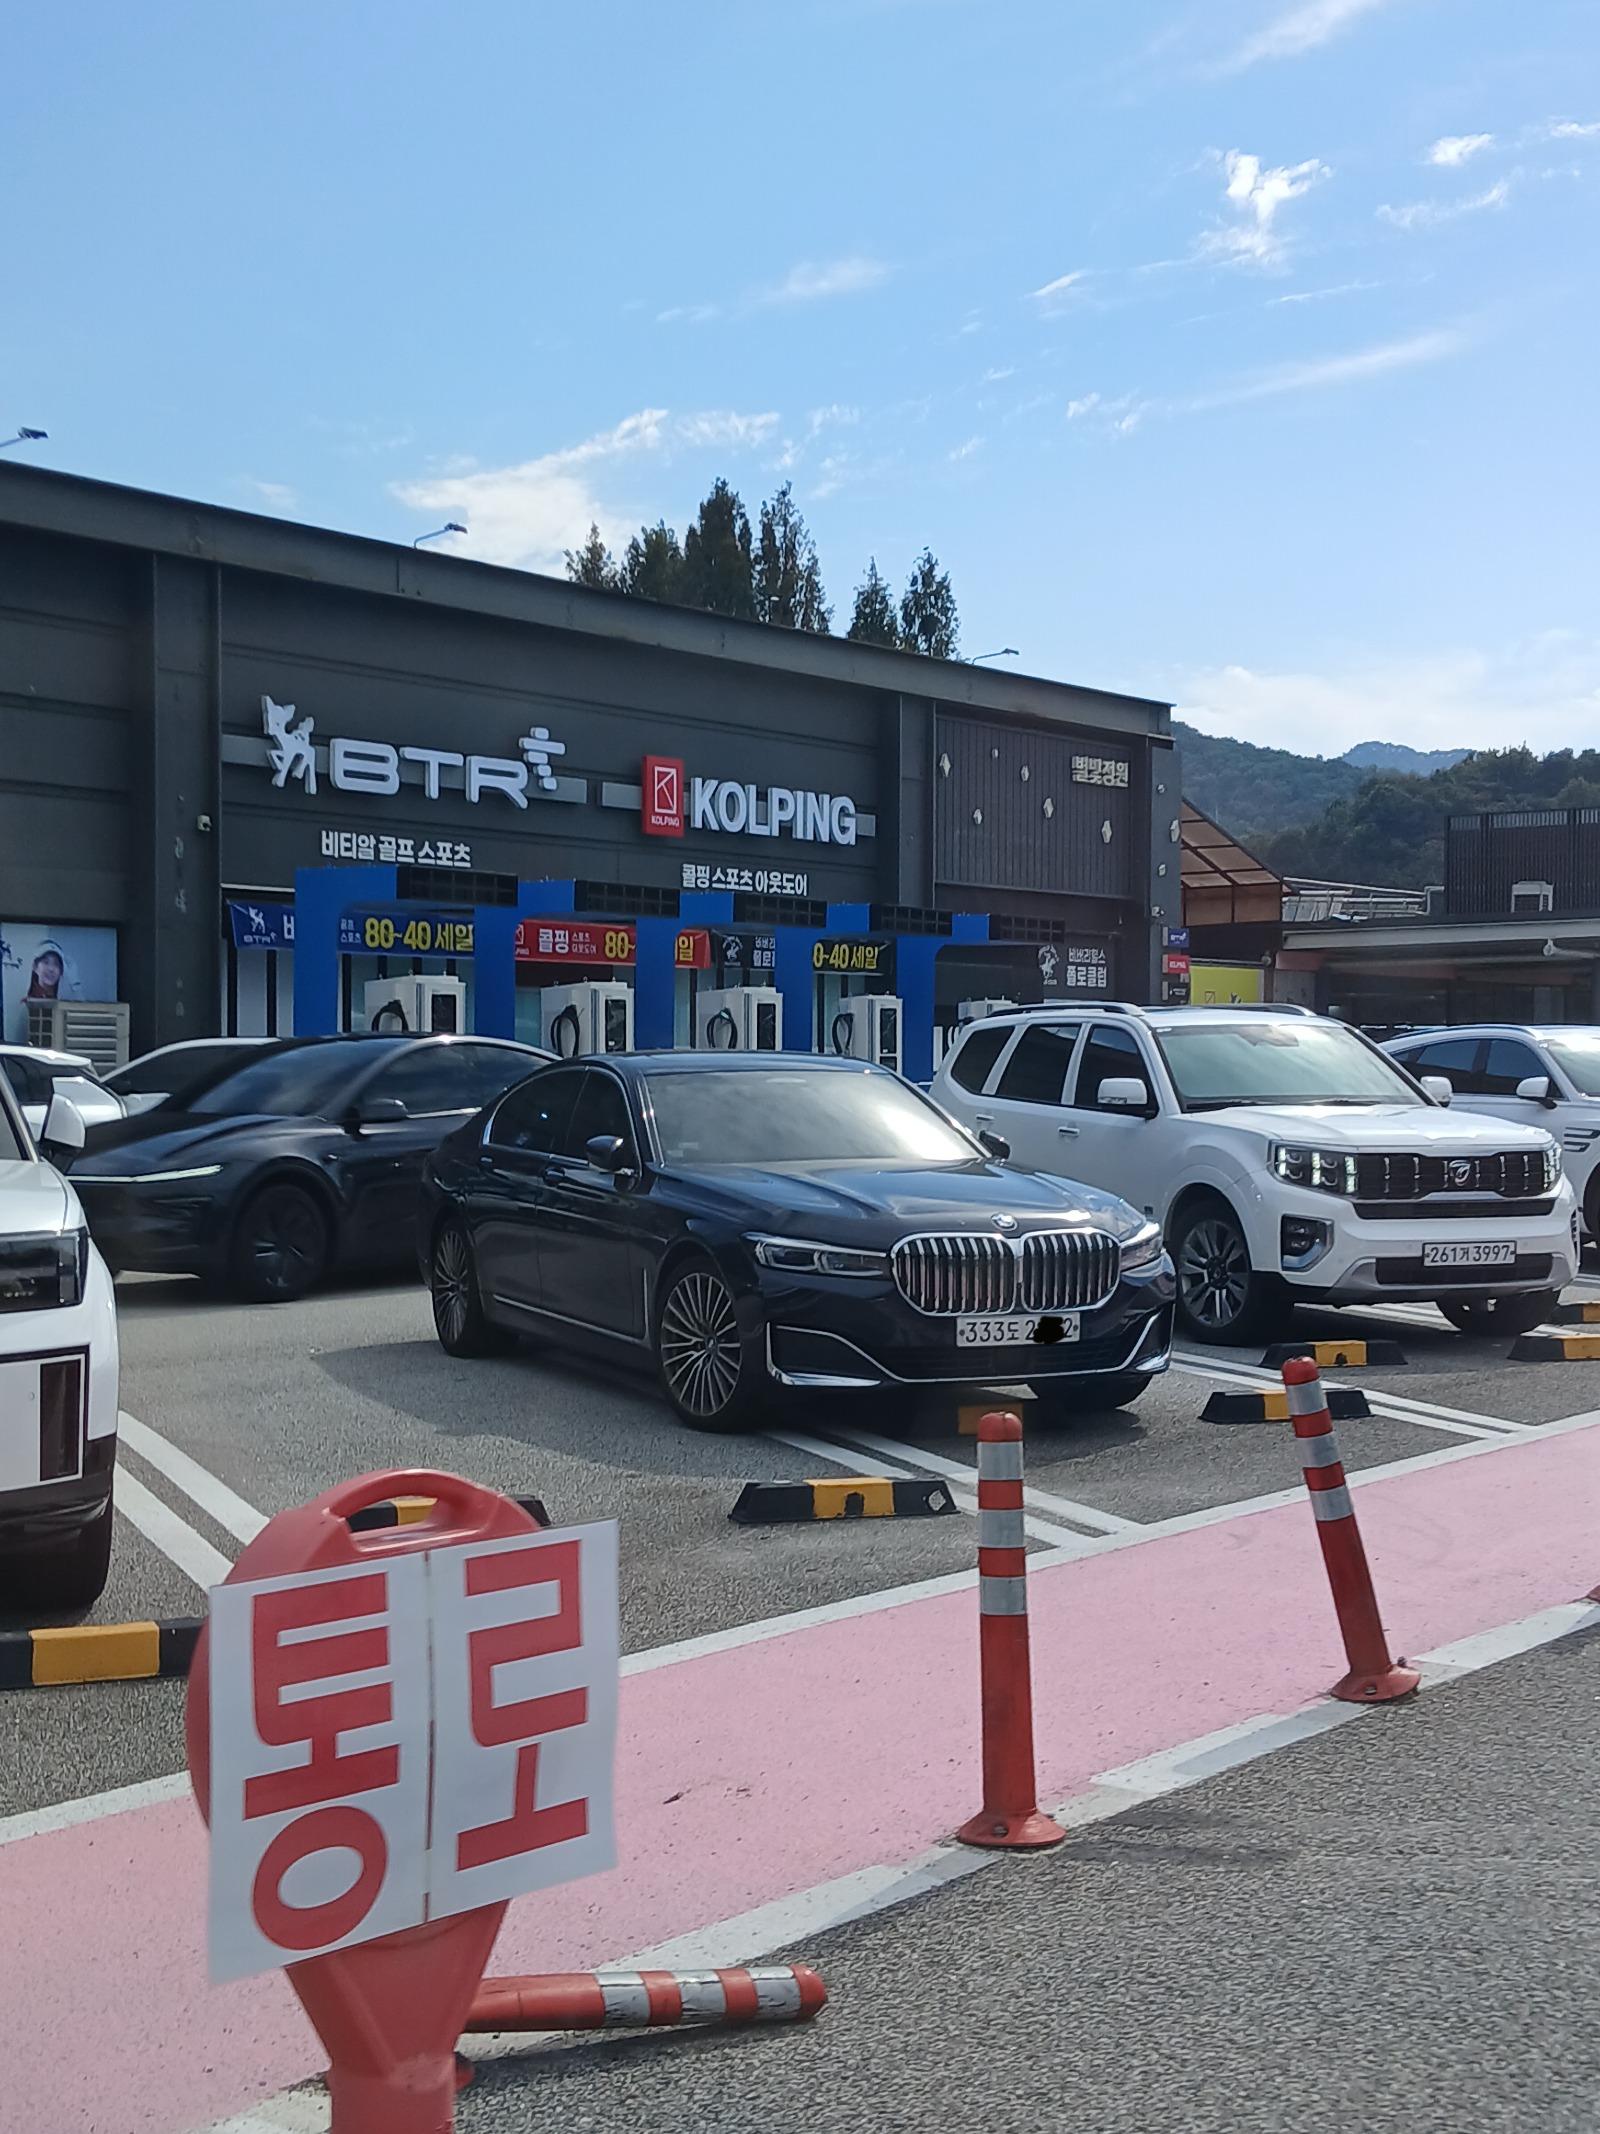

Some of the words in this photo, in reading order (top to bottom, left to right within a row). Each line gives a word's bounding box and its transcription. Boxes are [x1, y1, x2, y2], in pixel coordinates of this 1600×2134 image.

[329, 737, 529, 810] BTR
[1072, 756, 1128, 787] 별빛정원
[651, 815, 680, 827] KOLPING
[691, 777, 856, 846] KOLPING
[321, 830, 376, 860] 비티알
[379, 835, 415, 863] 골프
[418, 840, 471, 868] 스포츠
[682, 863, 711, 888] 콜핑
[712, 867, 753, 891] 스포츠
[365, 917, 431, 950] 80~40
[434, 922, 474, 952] 세일
[539, 928, 569, 953] 콜핑
[604, 930, 636, 959] 80~
[675, 936, 694, 961] 일
[813, 942, 849, 968] 0~40
[851, 945, 878, 969] 세일
[1025, 1317, 1073, 1341] 22
[243, 1540, 589, 1951] 통로
